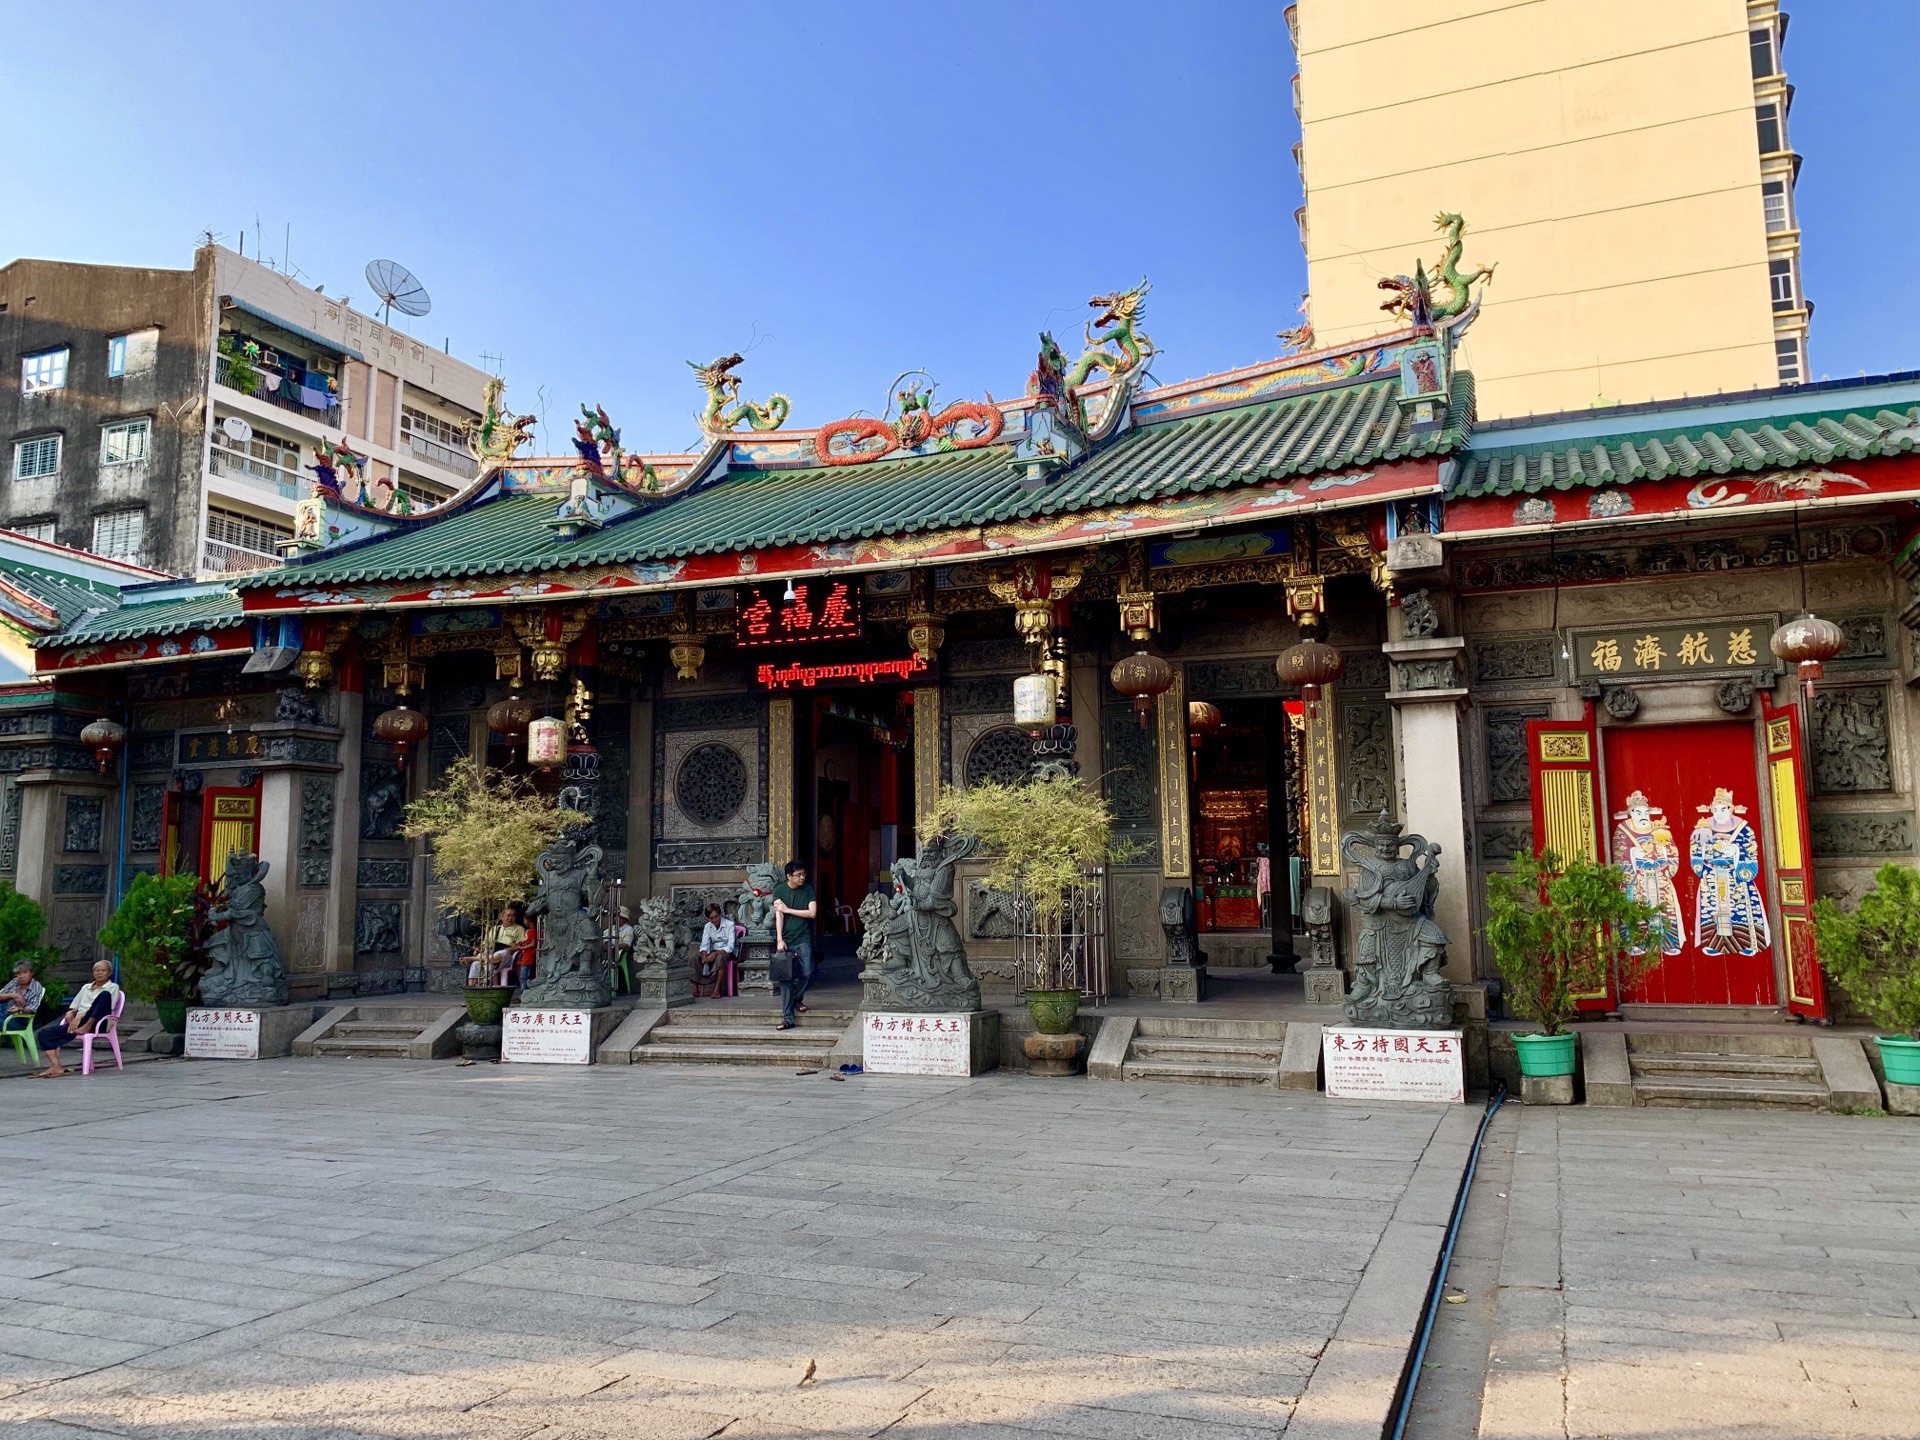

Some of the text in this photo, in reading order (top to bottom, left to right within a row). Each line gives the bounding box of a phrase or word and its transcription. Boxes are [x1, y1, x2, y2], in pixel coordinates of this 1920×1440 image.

[510, 1012, 582, 1026] 西方廣目天王
[871, 1016, 960, 1033] 南方增長天王
[1332, 1034, 1452, 1054] 東方持國天王
